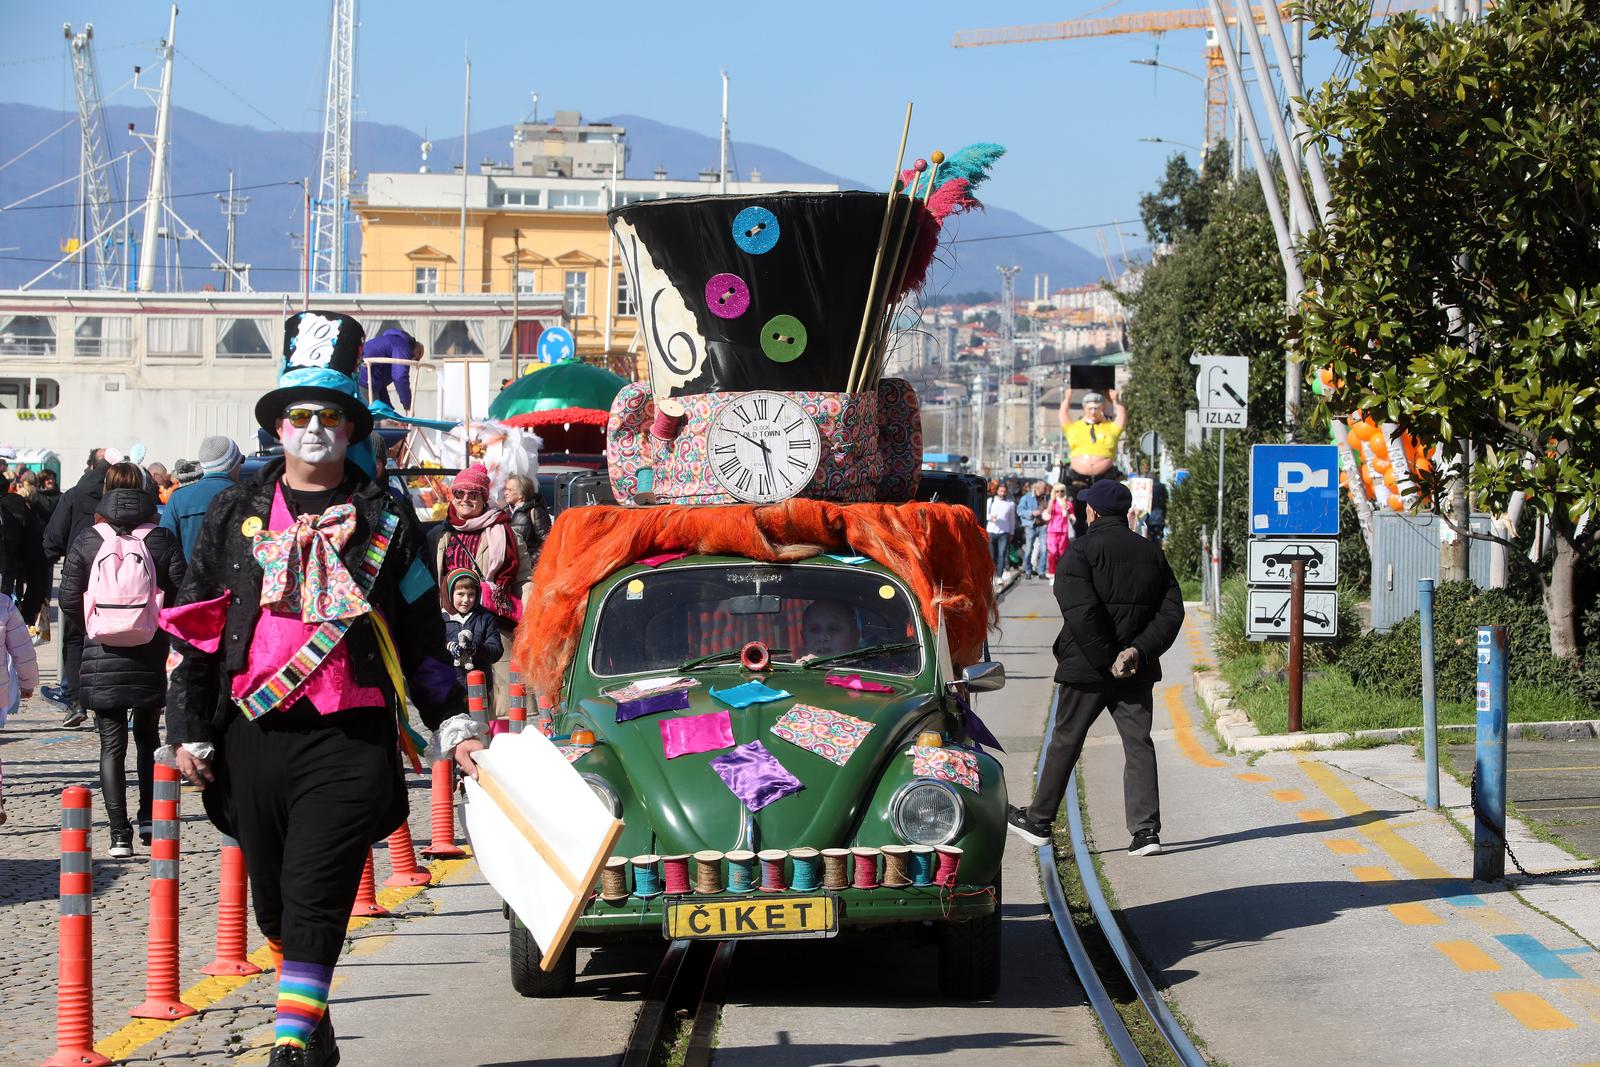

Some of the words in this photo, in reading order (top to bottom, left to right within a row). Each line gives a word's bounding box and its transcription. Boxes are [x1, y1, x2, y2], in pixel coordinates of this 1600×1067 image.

[1206, 412, 1241, 424] IZLAZ
[760, 430, 781, 438] TOWN
[688, 903, 813, 934] ČIKET
